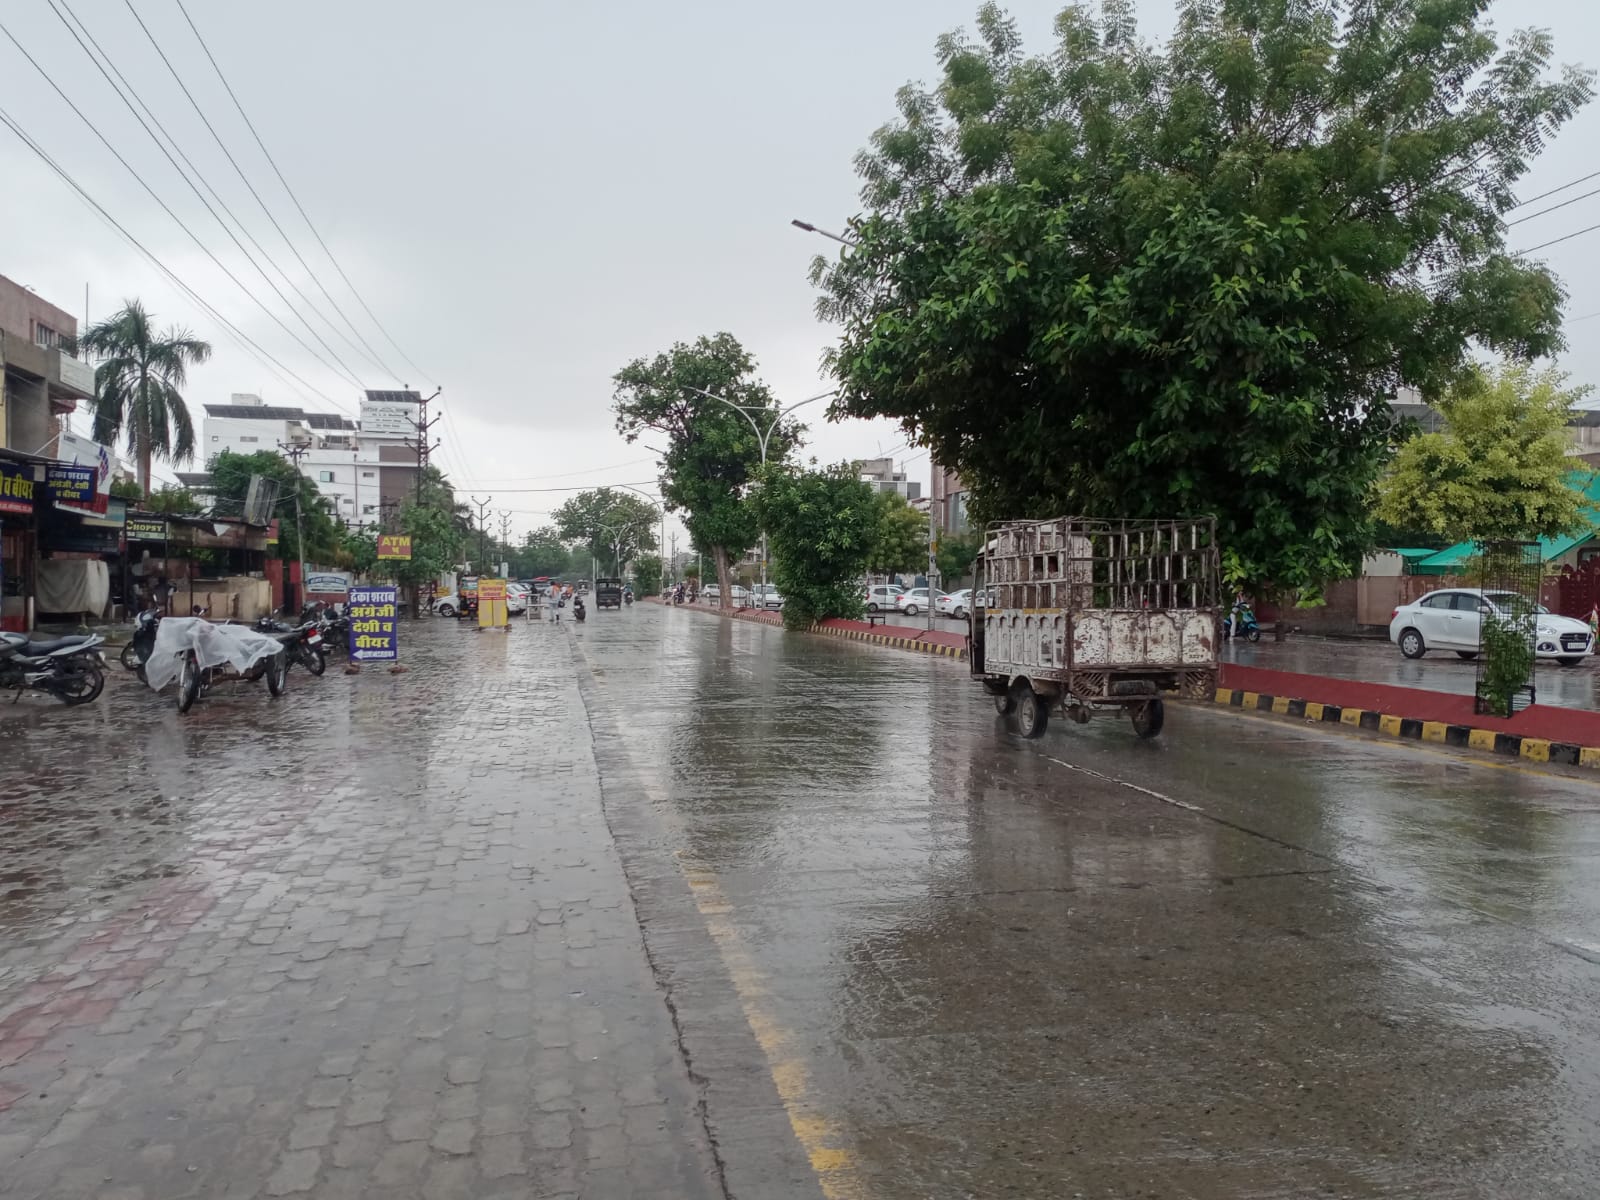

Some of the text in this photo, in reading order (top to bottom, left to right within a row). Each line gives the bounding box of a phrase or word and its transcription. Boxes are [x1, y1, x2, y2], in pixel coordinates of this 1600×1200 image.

[12, 473, 34, 500] बीयर
[382, 536, 411, 546] ATM
[370, 591, 395, 602] शराब
[351, 604, 395, 617] अंग्रेजी
[353, 620, 392, 632] देशी व
[355, 635, 391, 648] बीयर
